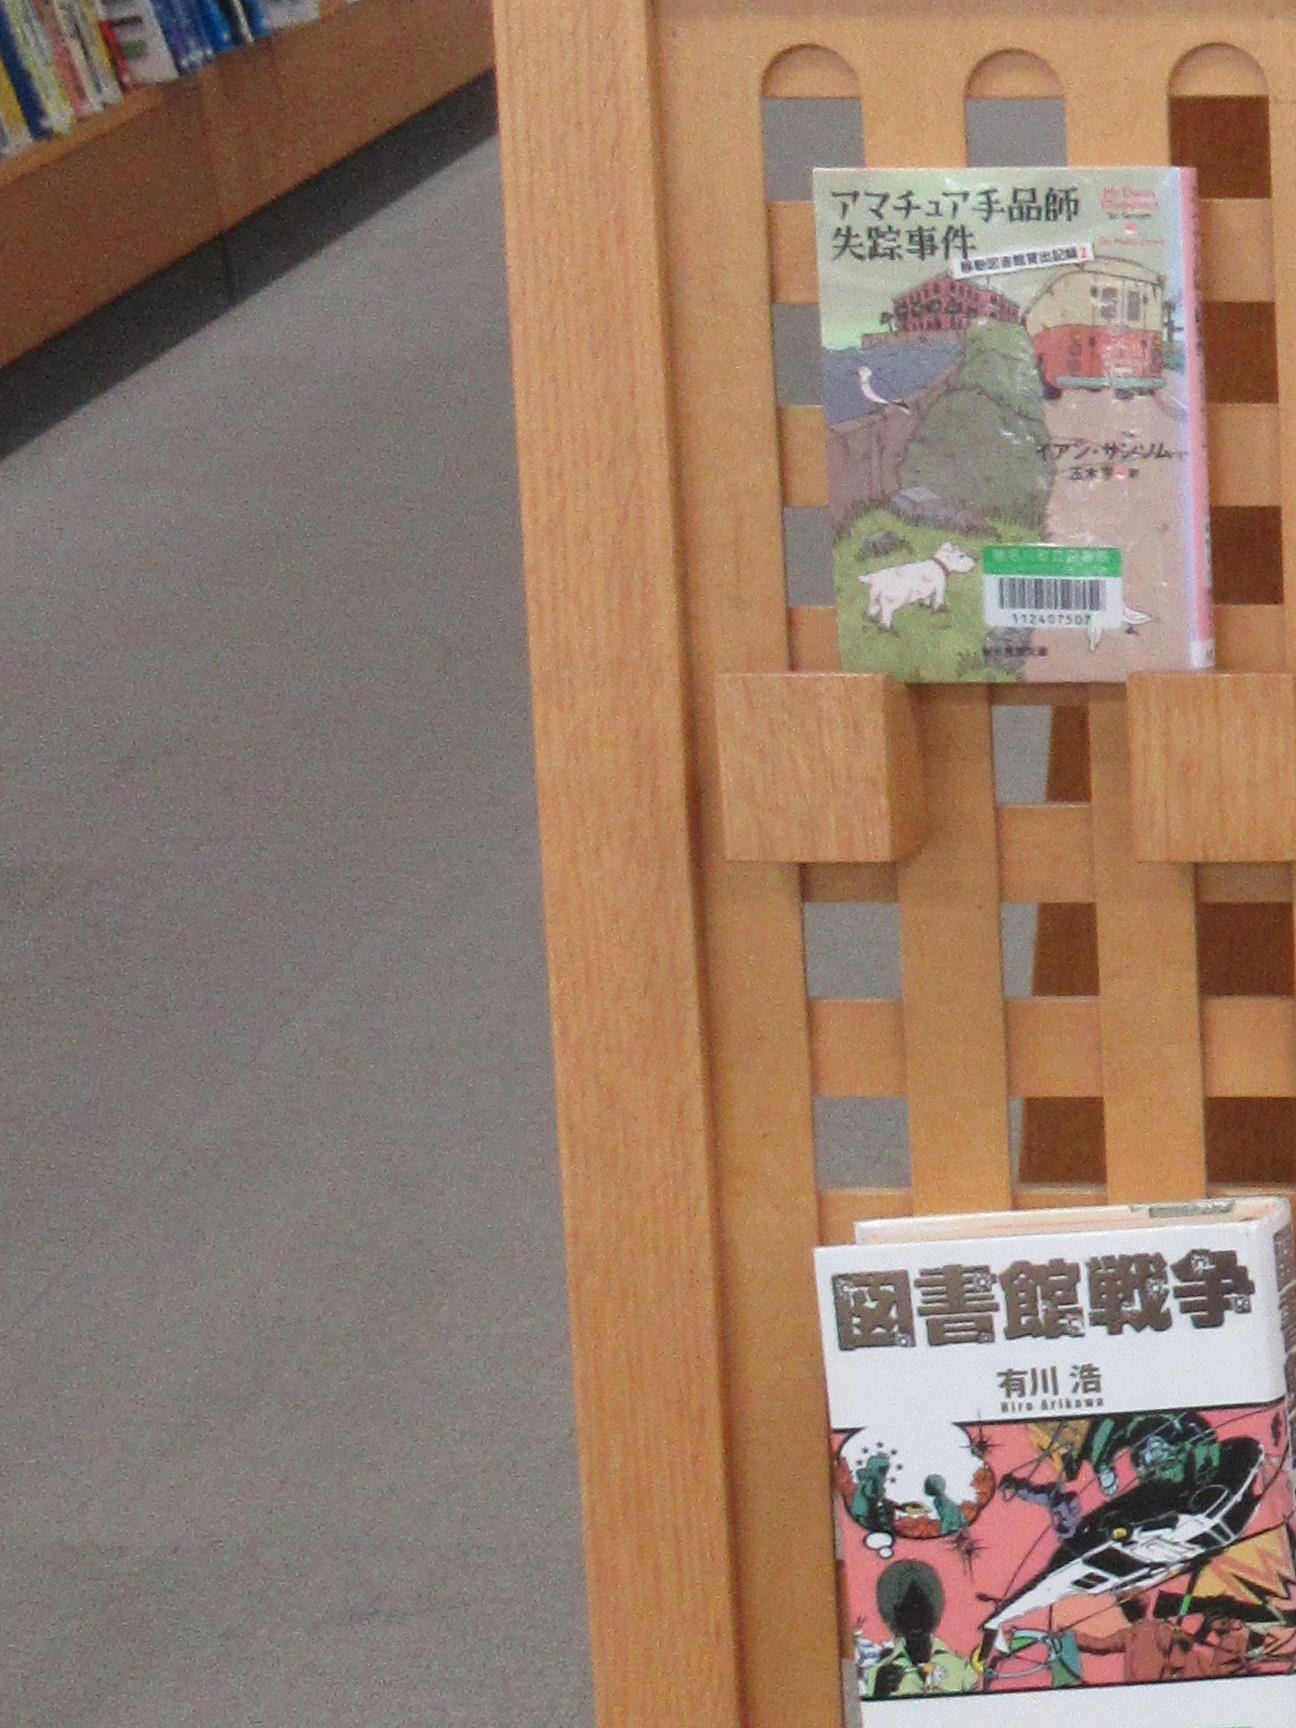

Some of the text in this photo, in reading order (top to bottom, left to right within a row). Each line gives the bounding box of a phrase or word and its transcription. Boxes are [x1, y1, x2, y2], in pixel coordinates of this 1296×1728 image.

[830, 185, 1080, 224] アマチュア手品師
[831, 223, 976, 262] 失踪事件
[1011, 612, 1092, 625] 112407507
[832, 1248, 1256, 1351] 図書館戦争
[996, 1362, 1105, 1399] 有川 浩
